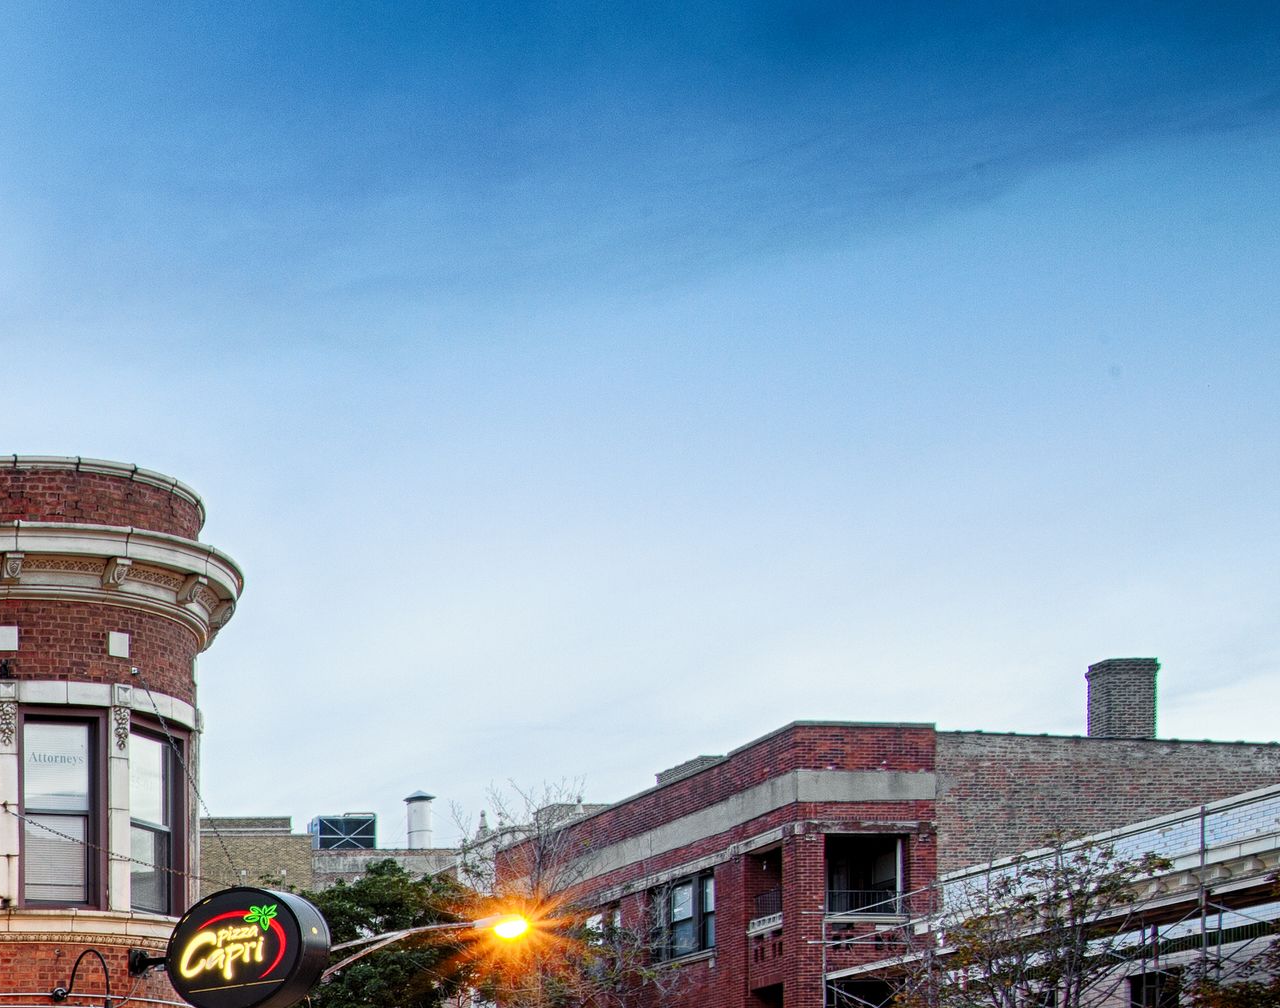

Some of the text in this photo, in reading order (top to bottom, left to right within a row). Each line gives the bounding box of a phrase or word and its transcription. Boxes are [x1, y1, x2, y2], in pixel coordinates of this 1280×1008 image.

[30, 752, 83, 766] Attorneys
[216, 924, 259, 948] pizza
[179, 931, 265, 980] Capri
